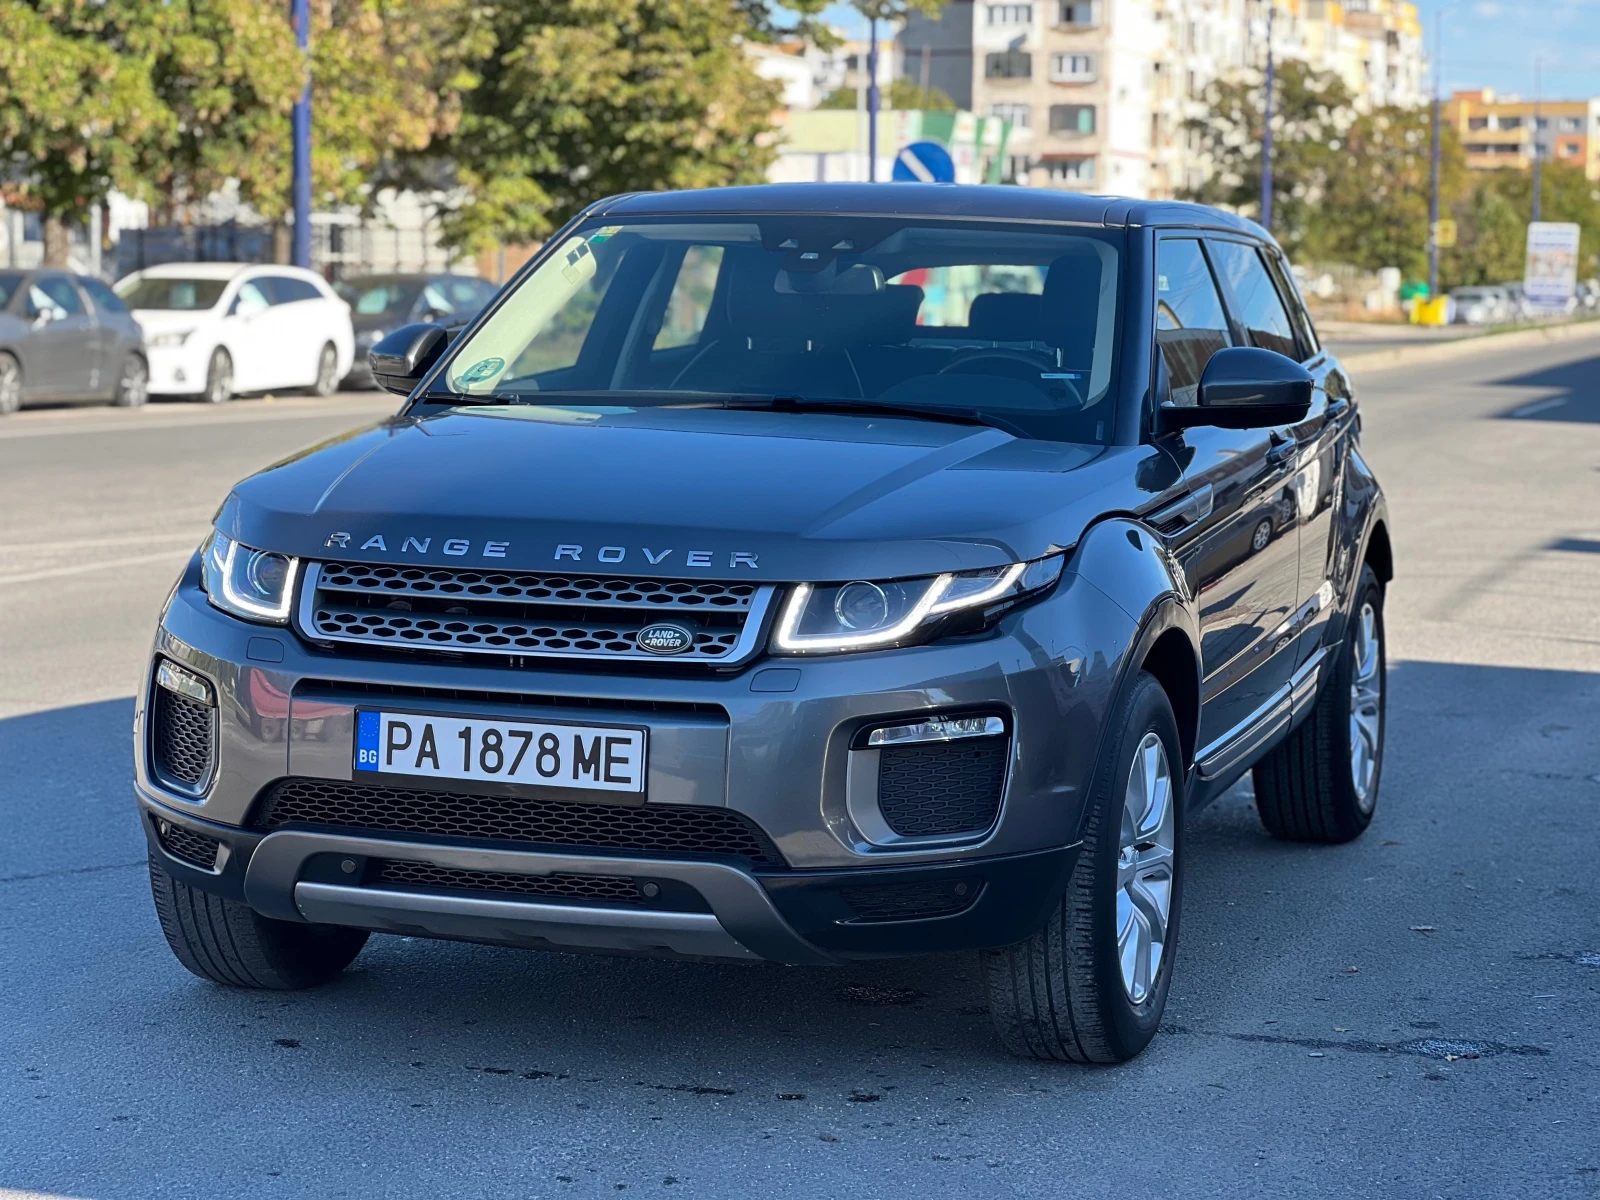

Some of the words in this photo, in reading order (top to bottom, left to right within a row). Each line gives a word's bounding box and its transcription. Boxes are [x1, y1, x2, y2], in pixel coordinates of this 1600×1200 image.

[324, 531, 510, 558] RANGE
[554, 544, 759, 569] ROVER
[359, 749, 378, 764] BG
[386, 720, 440, 770] PA
[458, 726, 561, 779] 1878
[572, 734, 633, 784] ME
